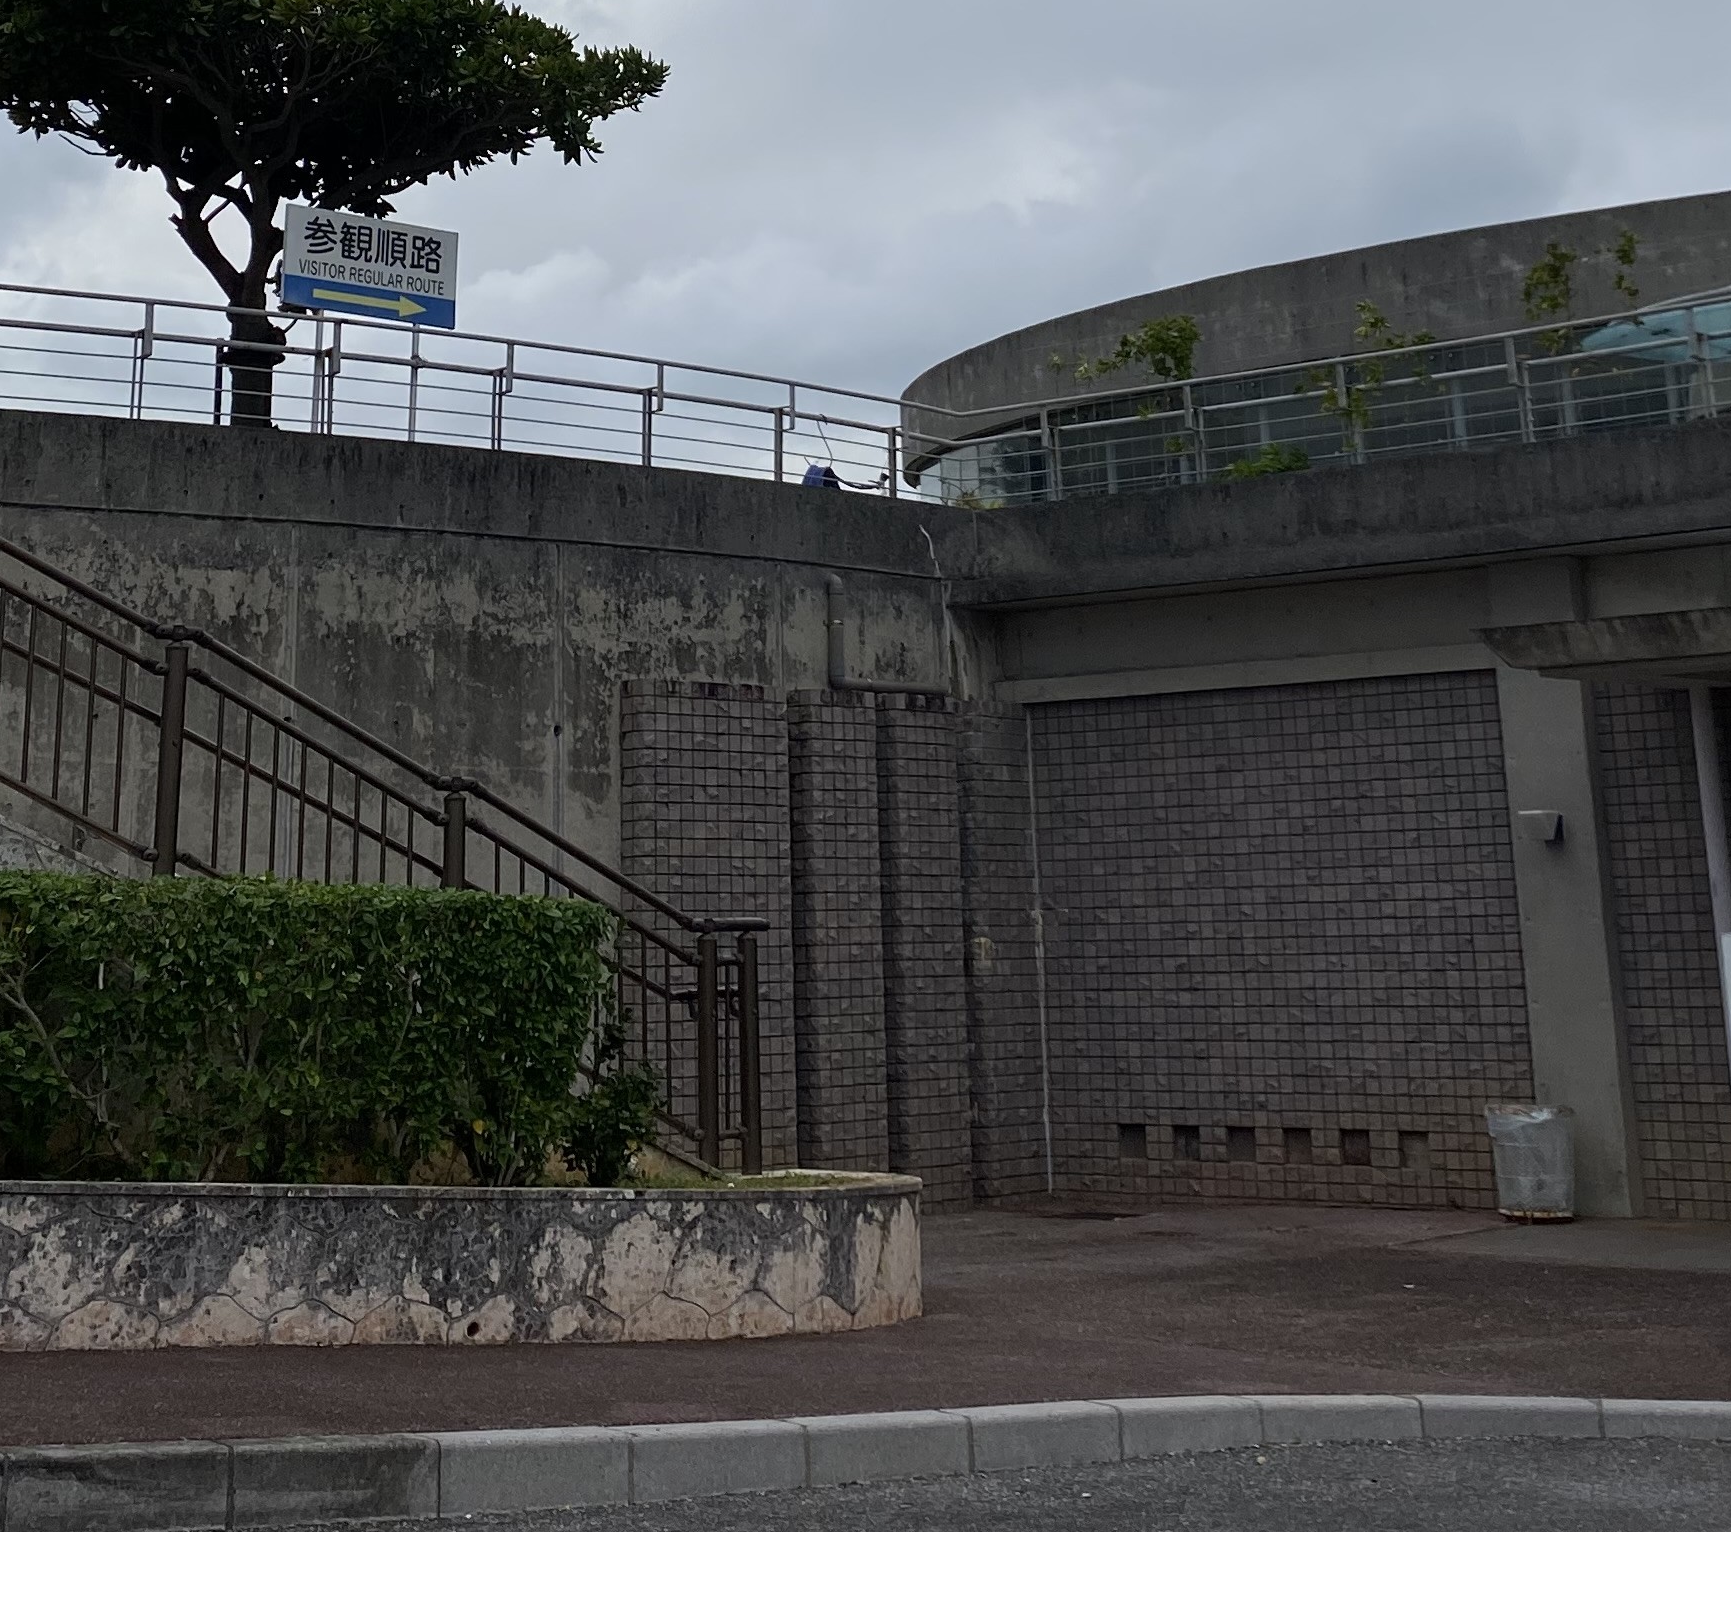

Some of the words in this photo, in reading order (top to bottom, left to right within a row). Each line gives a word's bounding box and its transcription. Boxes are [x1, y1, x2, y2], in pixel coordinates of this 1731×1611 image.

[304, 216, 442, 274] 参観順路
[299, 258, 345, 281] VISITOR
[349, 266, 403, 289] REGULAR
[406, 276, 445, 296] ROUTE
